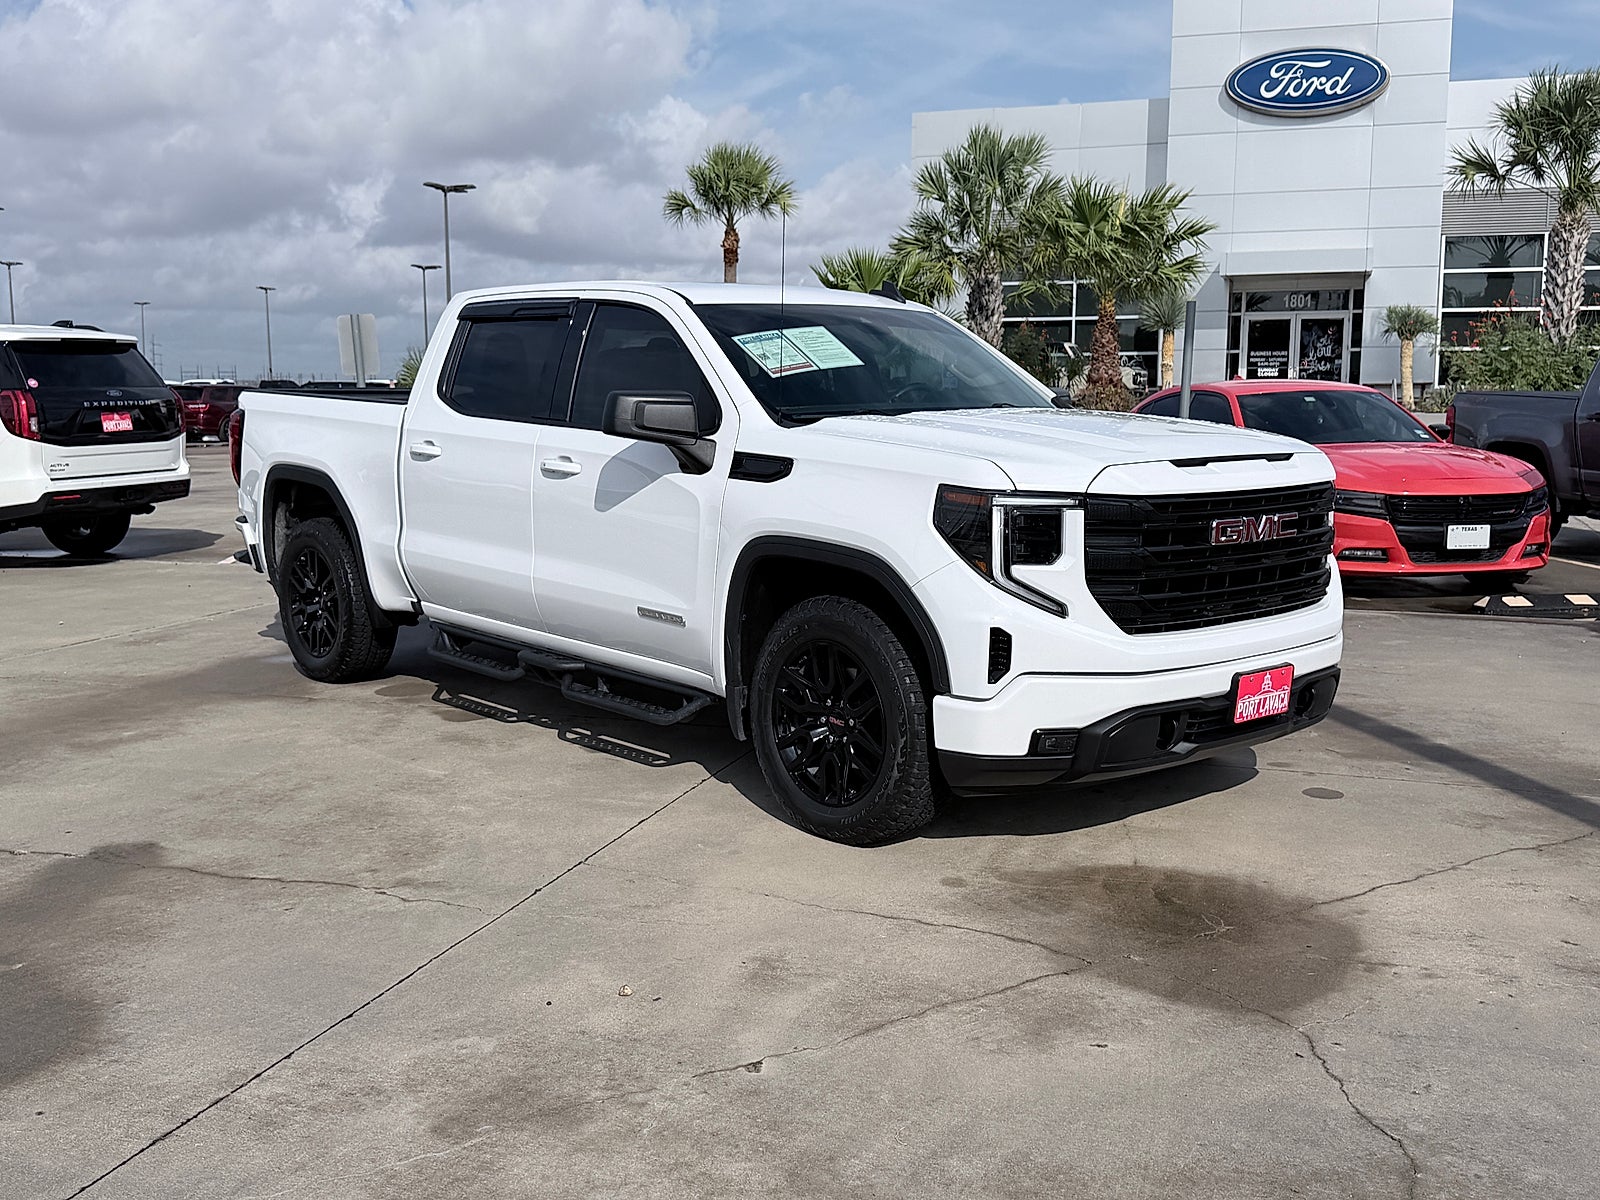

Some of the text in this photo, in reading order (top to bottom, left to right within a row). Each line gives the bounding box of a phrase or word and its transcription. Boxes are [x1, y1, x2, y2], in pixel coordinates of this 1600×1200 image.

[1259, 59, 1355, 99] Ford
[1283, 293, 1312, 309] 1801
[83, 399, 152, 408] EXPEDITION
[1210, 511, 1299, 546] GMC
[1236, 692, 1289, 719] PORT LAVACA
[828, 716, 845, 727] GMC
